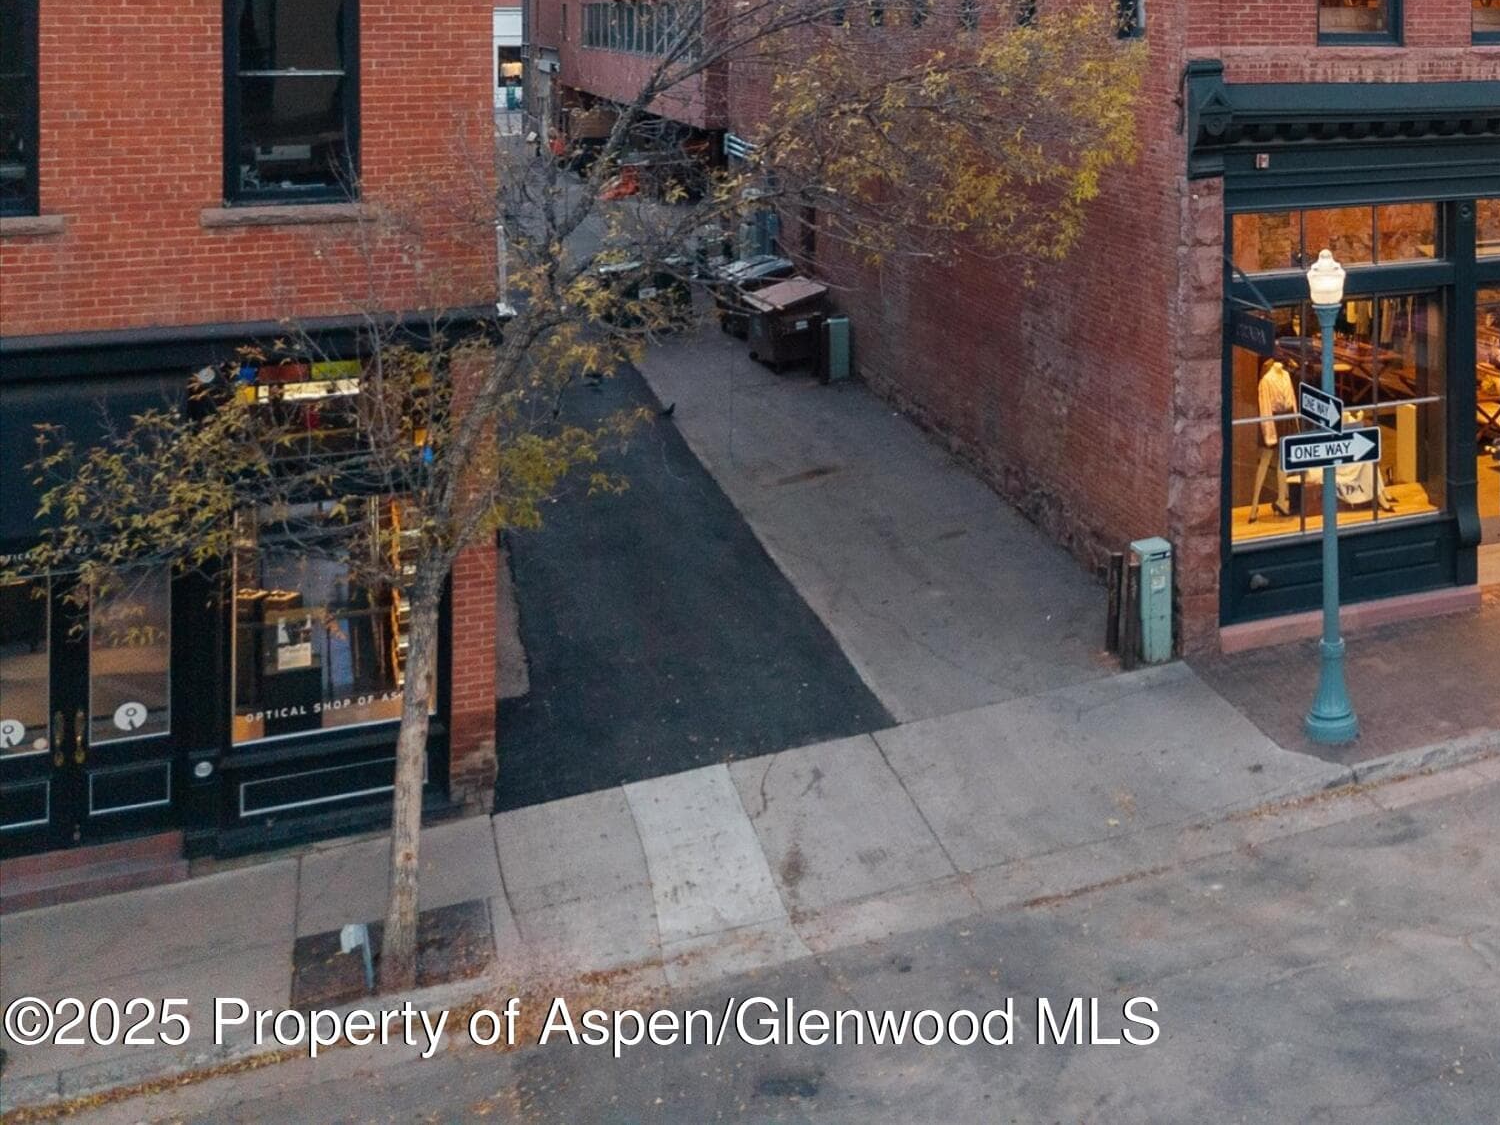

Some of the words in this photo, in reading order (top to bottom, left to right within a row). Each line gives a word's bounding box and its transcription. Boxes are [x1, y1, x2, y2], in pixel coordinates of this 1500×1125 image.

[1304, 394, 1316, 412] ONE
[1317, 401, 1330, 418] WAY
[1294, 444, 1321, 460] ONE
[1325, 441, 1352, 457] WAY
[245, 706, 307, 723] OPTICAL
[313, 698, 351, 714] SHOP
[357, 695, 374, 707] OF
